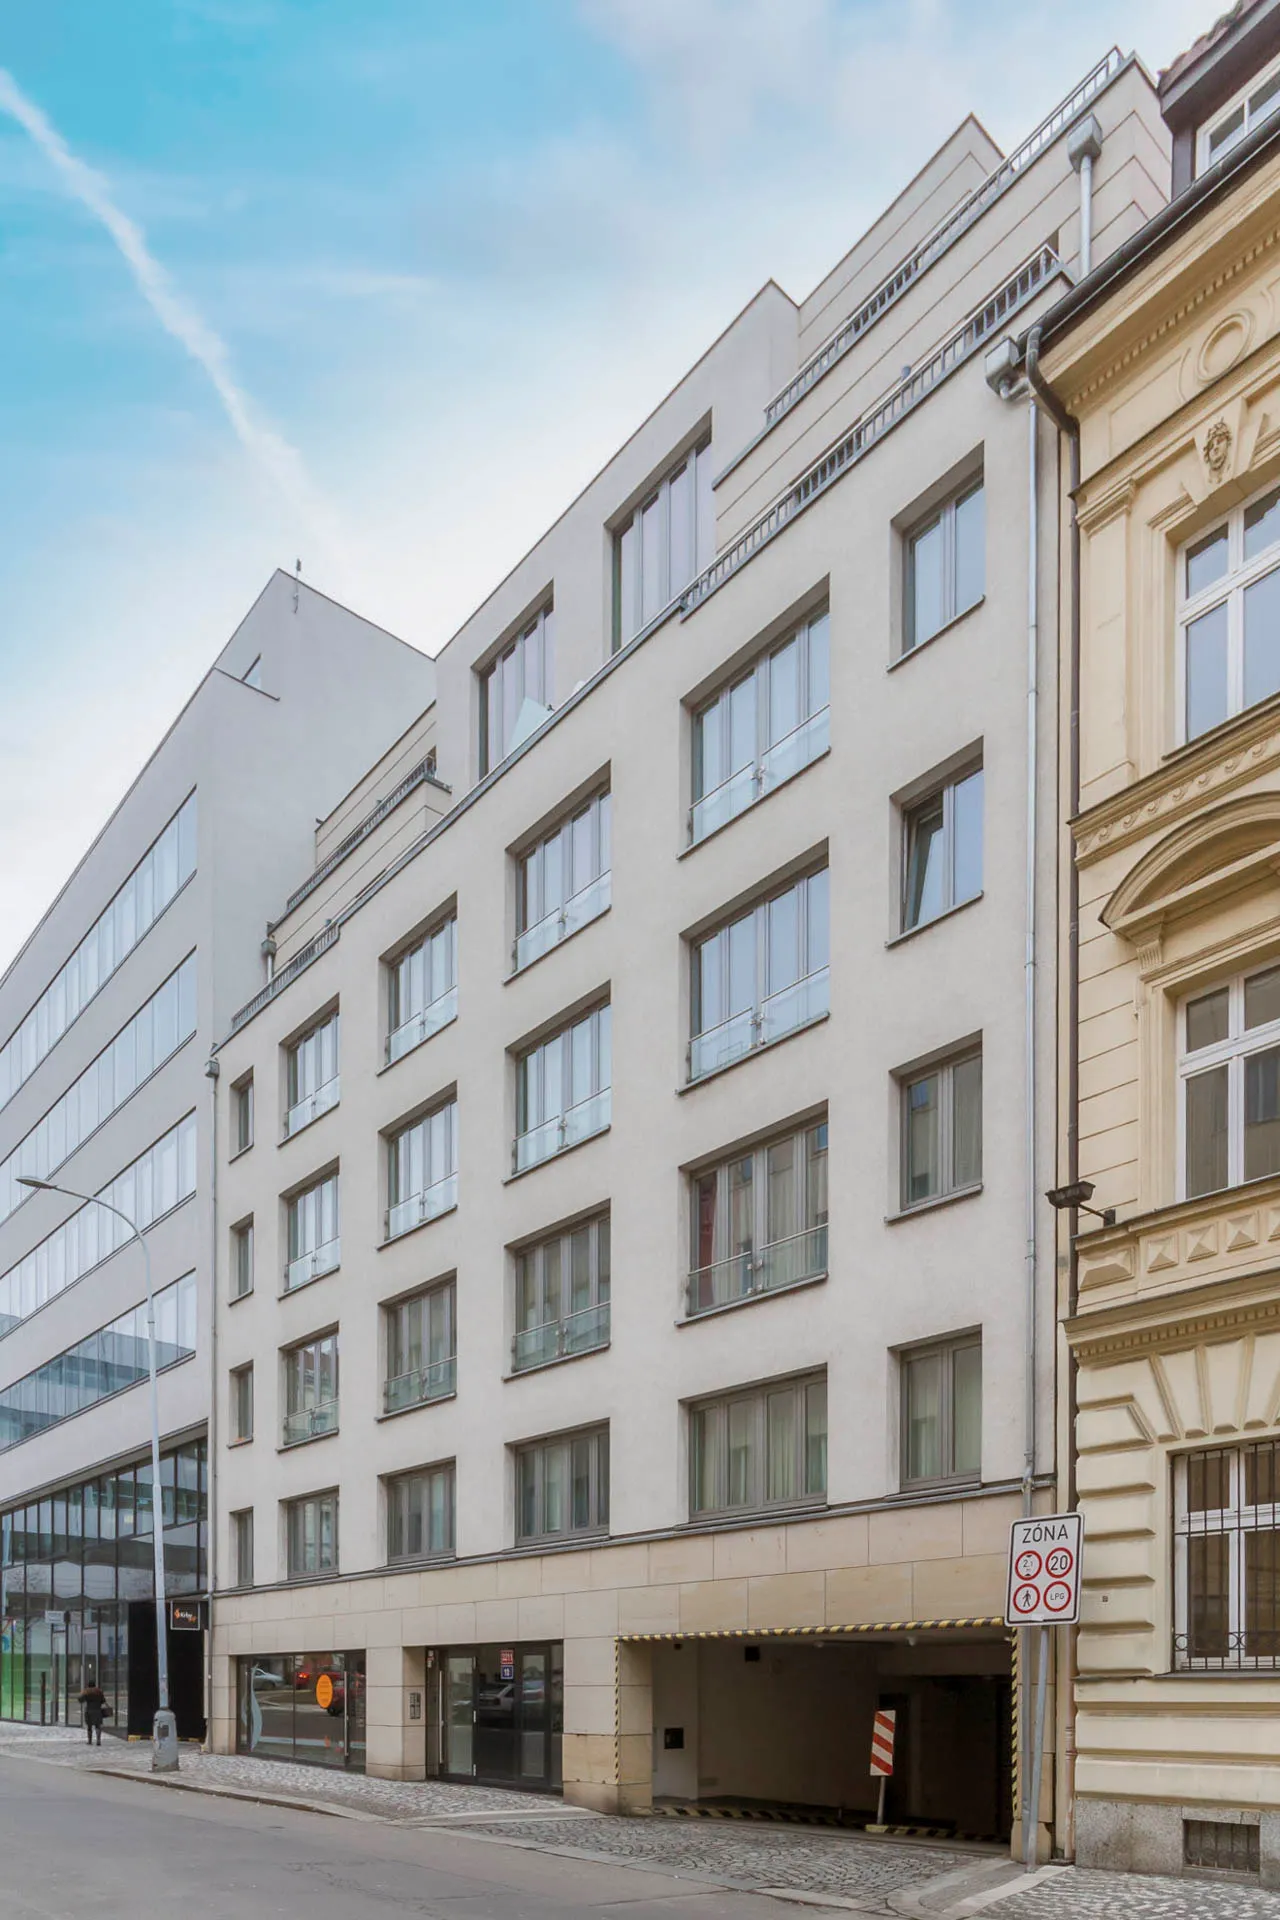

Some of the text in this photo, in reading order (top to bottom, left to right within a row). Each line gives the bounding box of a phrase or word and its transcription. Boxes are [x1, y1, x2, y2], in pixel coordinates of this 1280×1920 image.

[1022, 1524, 1069, 1543] ZÓNA
[1050, 1555, 1069, 1571] 20
[1050, 1592, 1065, 1600] LPG
